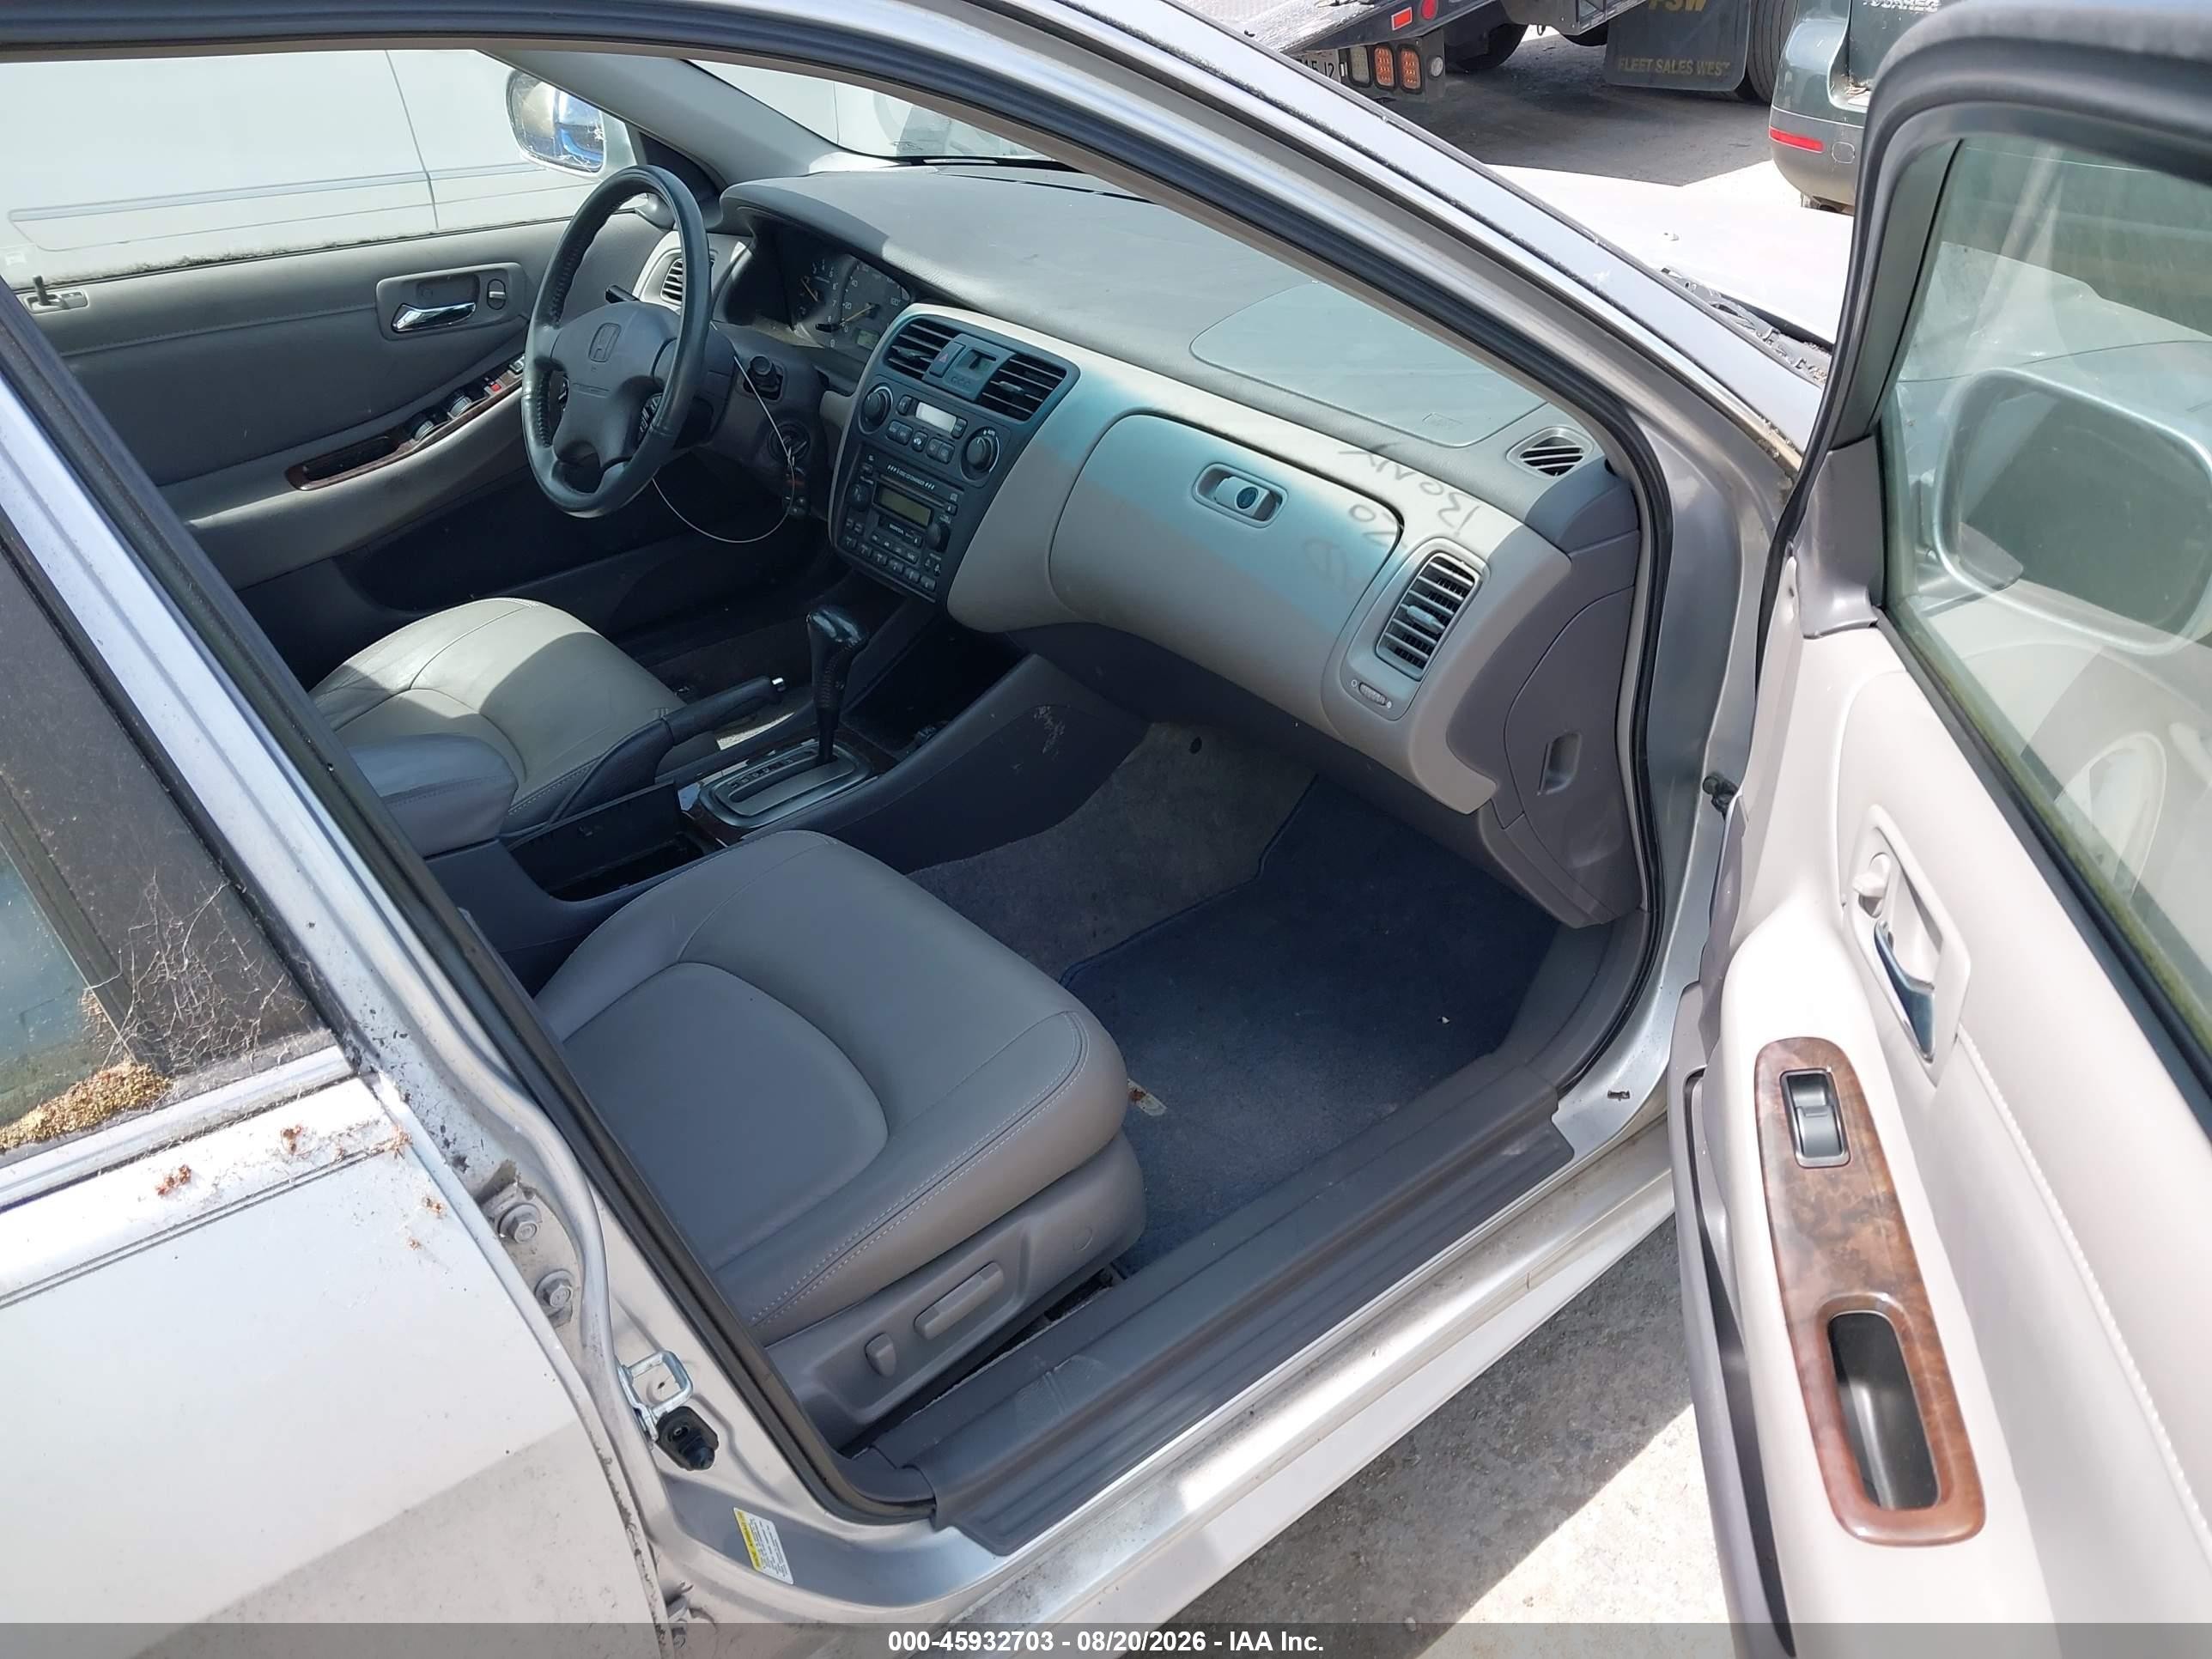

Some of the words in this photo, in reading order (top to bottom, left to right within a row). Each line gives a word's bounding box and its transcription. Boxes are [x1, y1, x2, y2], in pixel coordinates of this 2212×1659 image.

[1619, 58, 1653, 72] FLEET
[1655, 58, 1693, 75] SALES
[1696, 60, 1730, 76] WEST
